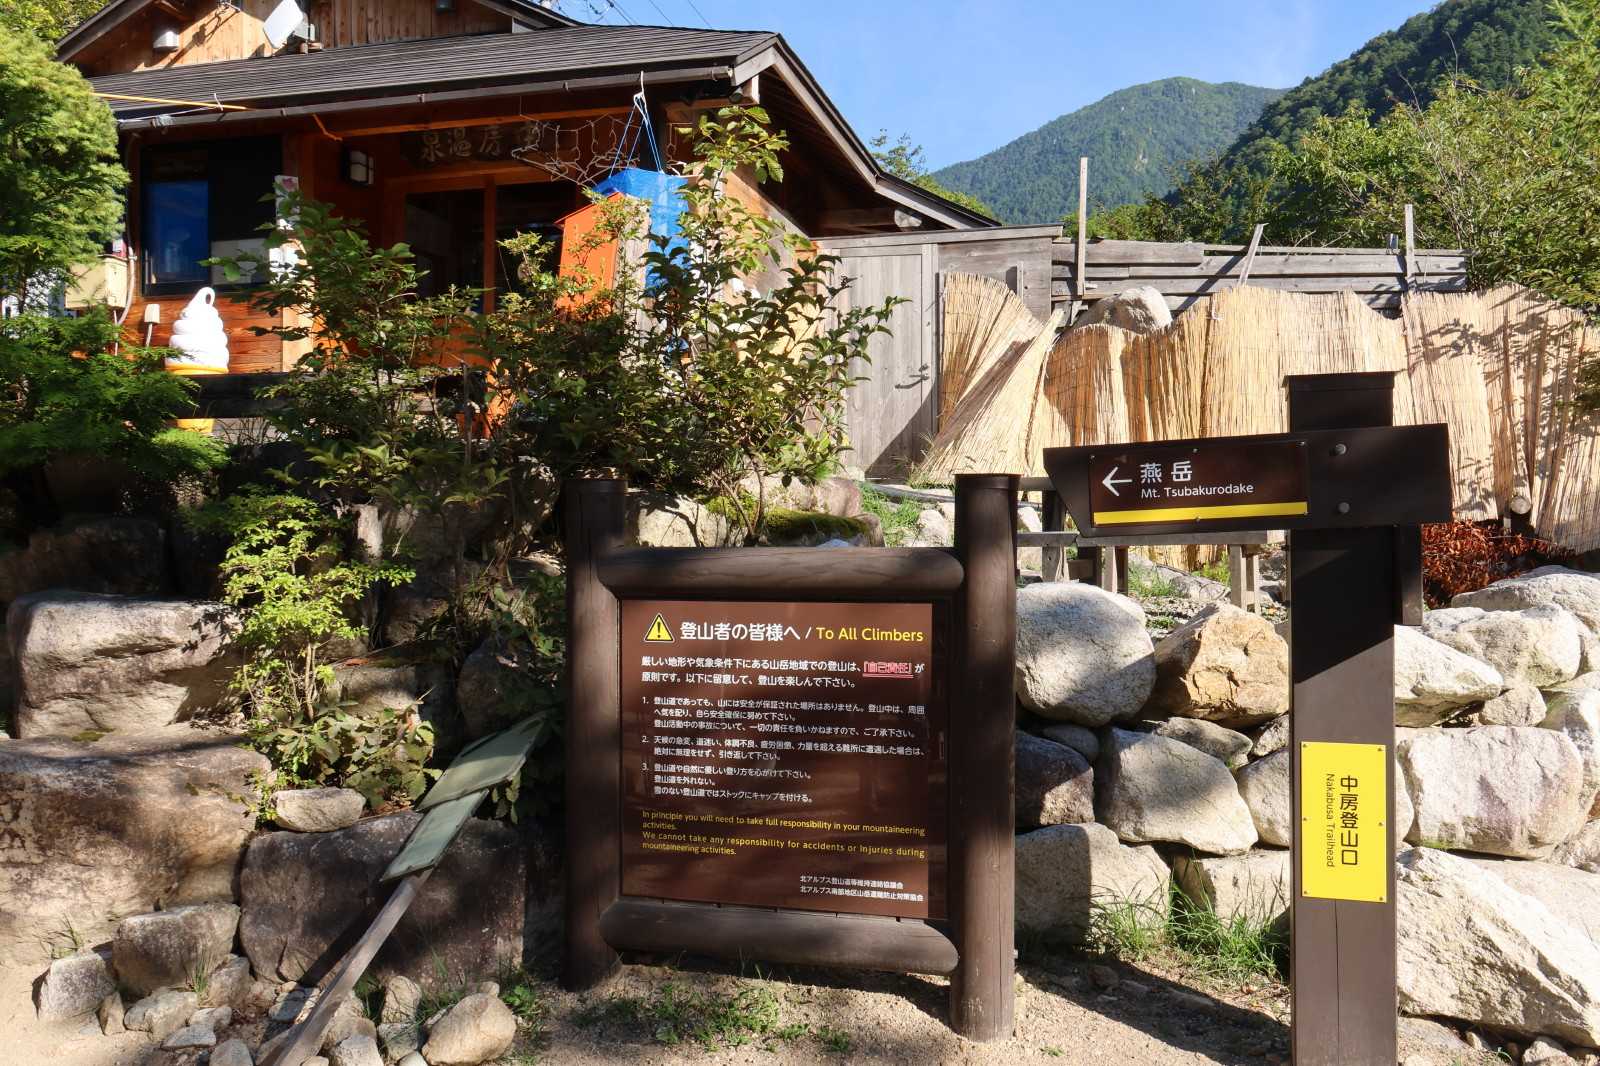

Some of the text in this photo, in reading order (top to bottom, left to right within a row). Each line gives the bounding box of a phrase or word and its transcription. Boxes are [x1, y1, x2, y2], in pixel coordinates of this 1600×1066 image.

[1140, 460, 1193, 484] 燕岳
[1141, 484, 1254, 499] Mt. Tsubakurodake
[680, 622, 801, 641] 登山者の皆様へ
[816, 627, 834, 640] To
[838, 628, 858, 640] All
[862, 628, 924, 642] Climbers
[642, 821, 677, 830] activities.
[651, 811, 683, 821] principle
[700, 814, 713, 822] will
[715, 816, 734, 824] need
[746, 817, 763, 826] take
[765, 818, 778, 827] full
[779, 820, 832, 831] responsibility
[833, 822, 841, 830] in
[843, 823, 860, 832] your
[862, 825, 925, 837] mountaineering
[1326, 773, 1336, 868] Nakabusa Trailhead
[1340, 775, 1359, 866] 中房登山口
[642, 832, 925, 859] We cannot take any responsibility for accidents or injuries during
[642, 842, 737, 855] mountaineering activities.
